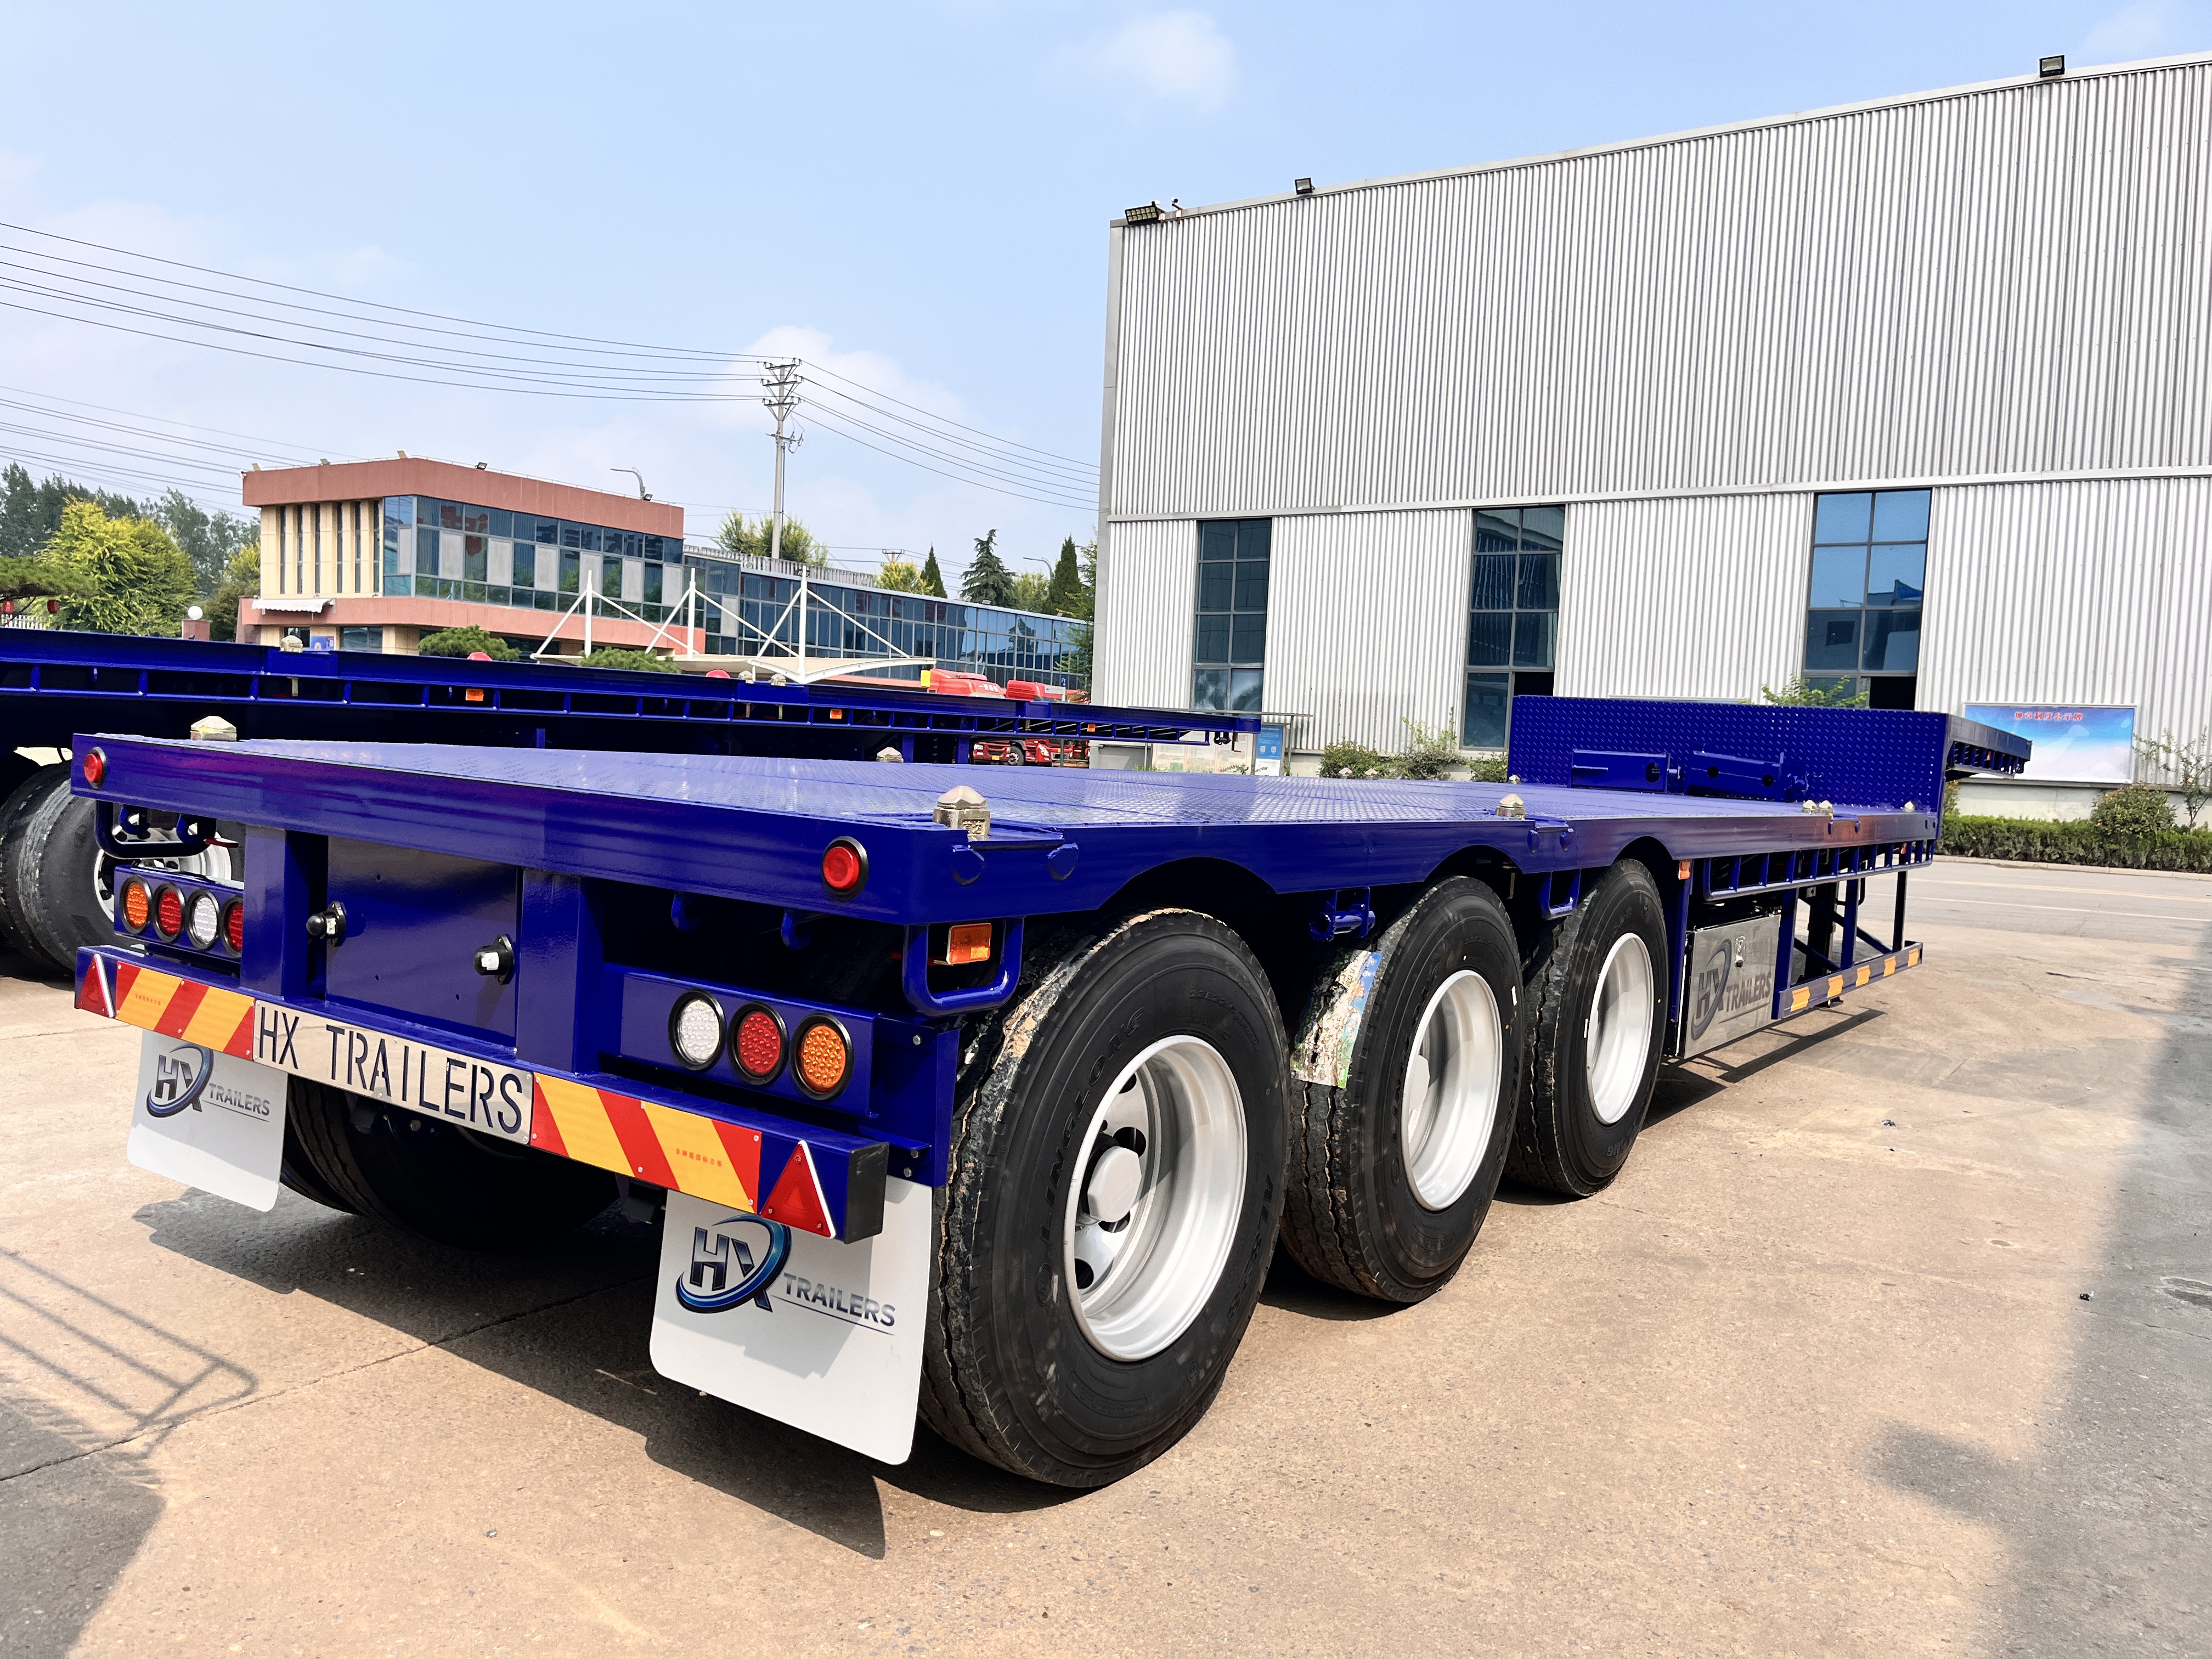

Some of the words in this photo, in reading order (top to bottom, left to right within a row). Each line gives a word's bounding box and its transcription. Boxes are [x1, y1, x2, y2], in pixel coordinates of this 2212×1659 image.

[1725, 972, 1772, 1013] TRAILERS
[259, 1006, 301, 1070] HX
[326, 1025, 523, 1134] TRAILERS
[208, 1082, 270, 1117] TRAILERS
[1039, 1006, 1144, 1243] LINGLONG
[782, 1272, 896, 1328] TRAILERS
